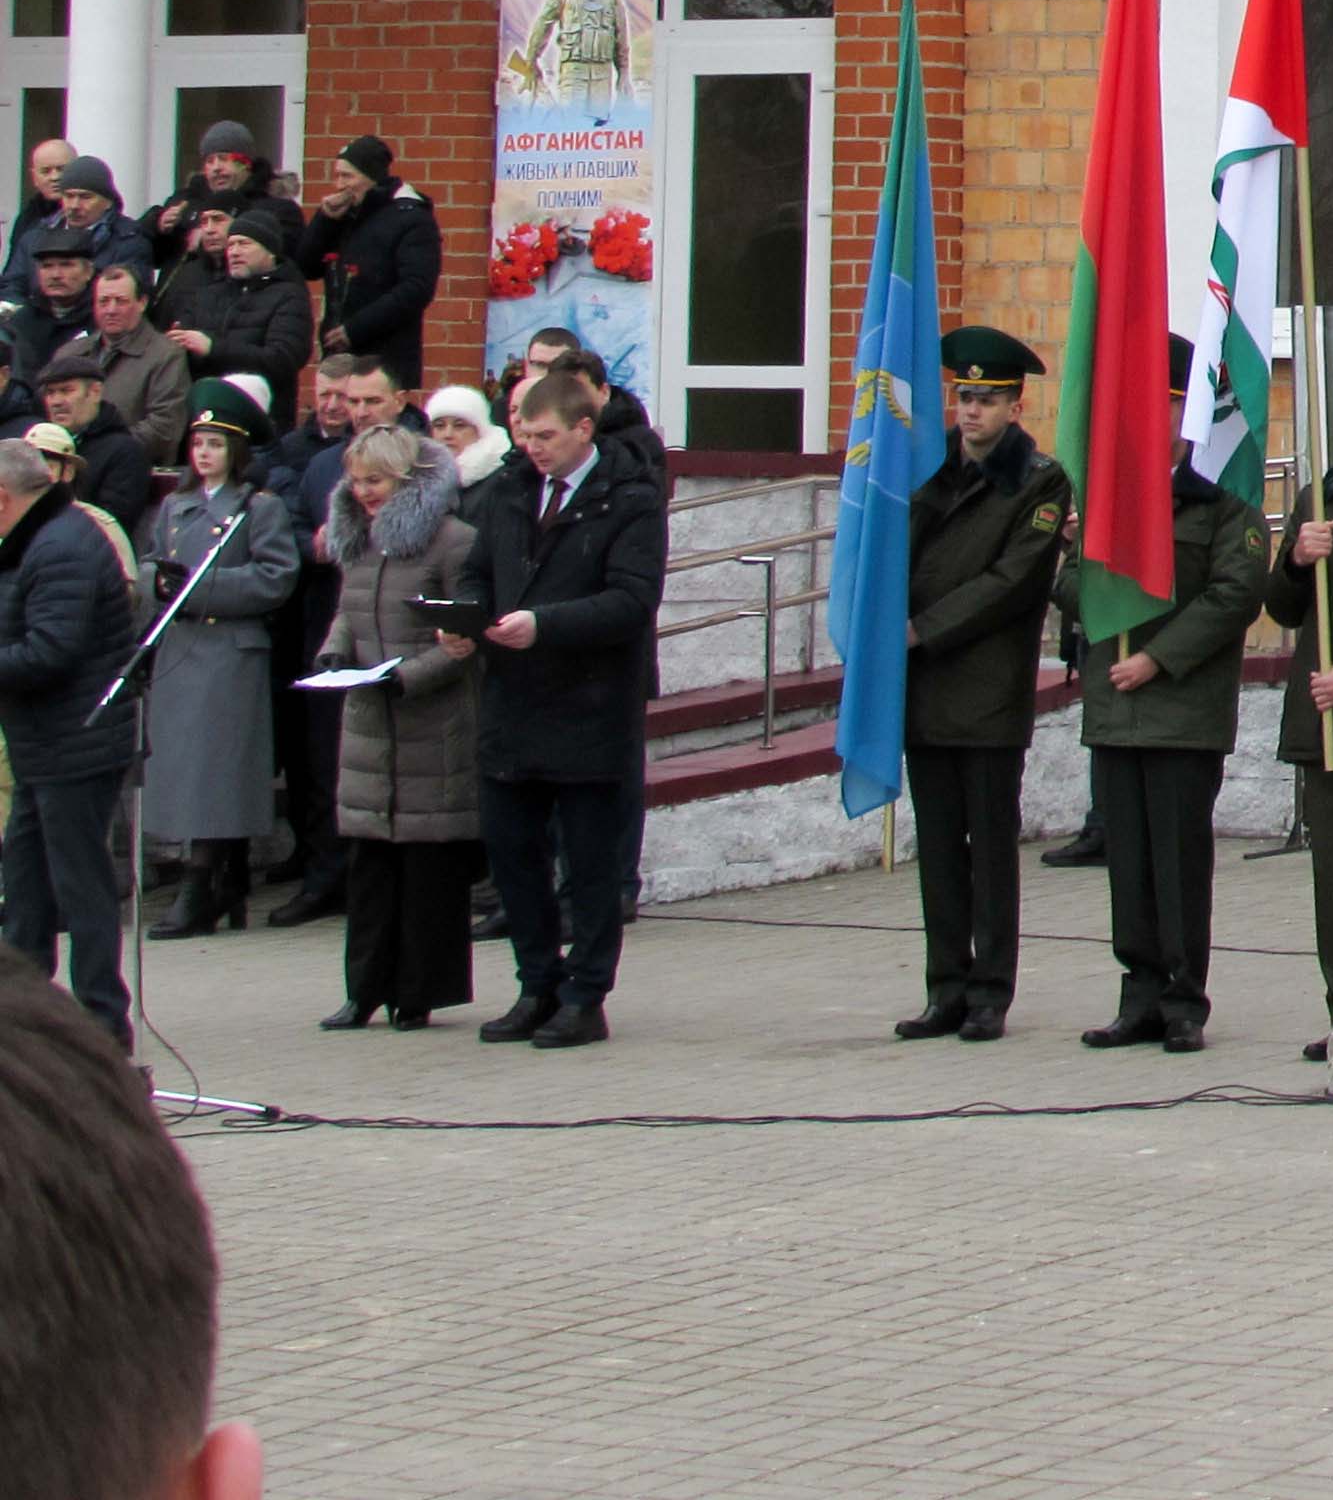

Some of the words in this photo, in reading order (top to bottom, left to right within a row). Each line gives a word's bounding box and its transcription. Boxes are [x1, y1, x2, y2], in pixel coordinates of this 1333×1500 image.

[503, 130, 644, 152] АФГАНИСТАН
[504, 162, 559, 180] ЖИВЫХ
[563, 162, 572, 179] И
[576, 160, 639, 178] ПАВШИХ
[537, 190, 603, 208] ПОМНИМ!
